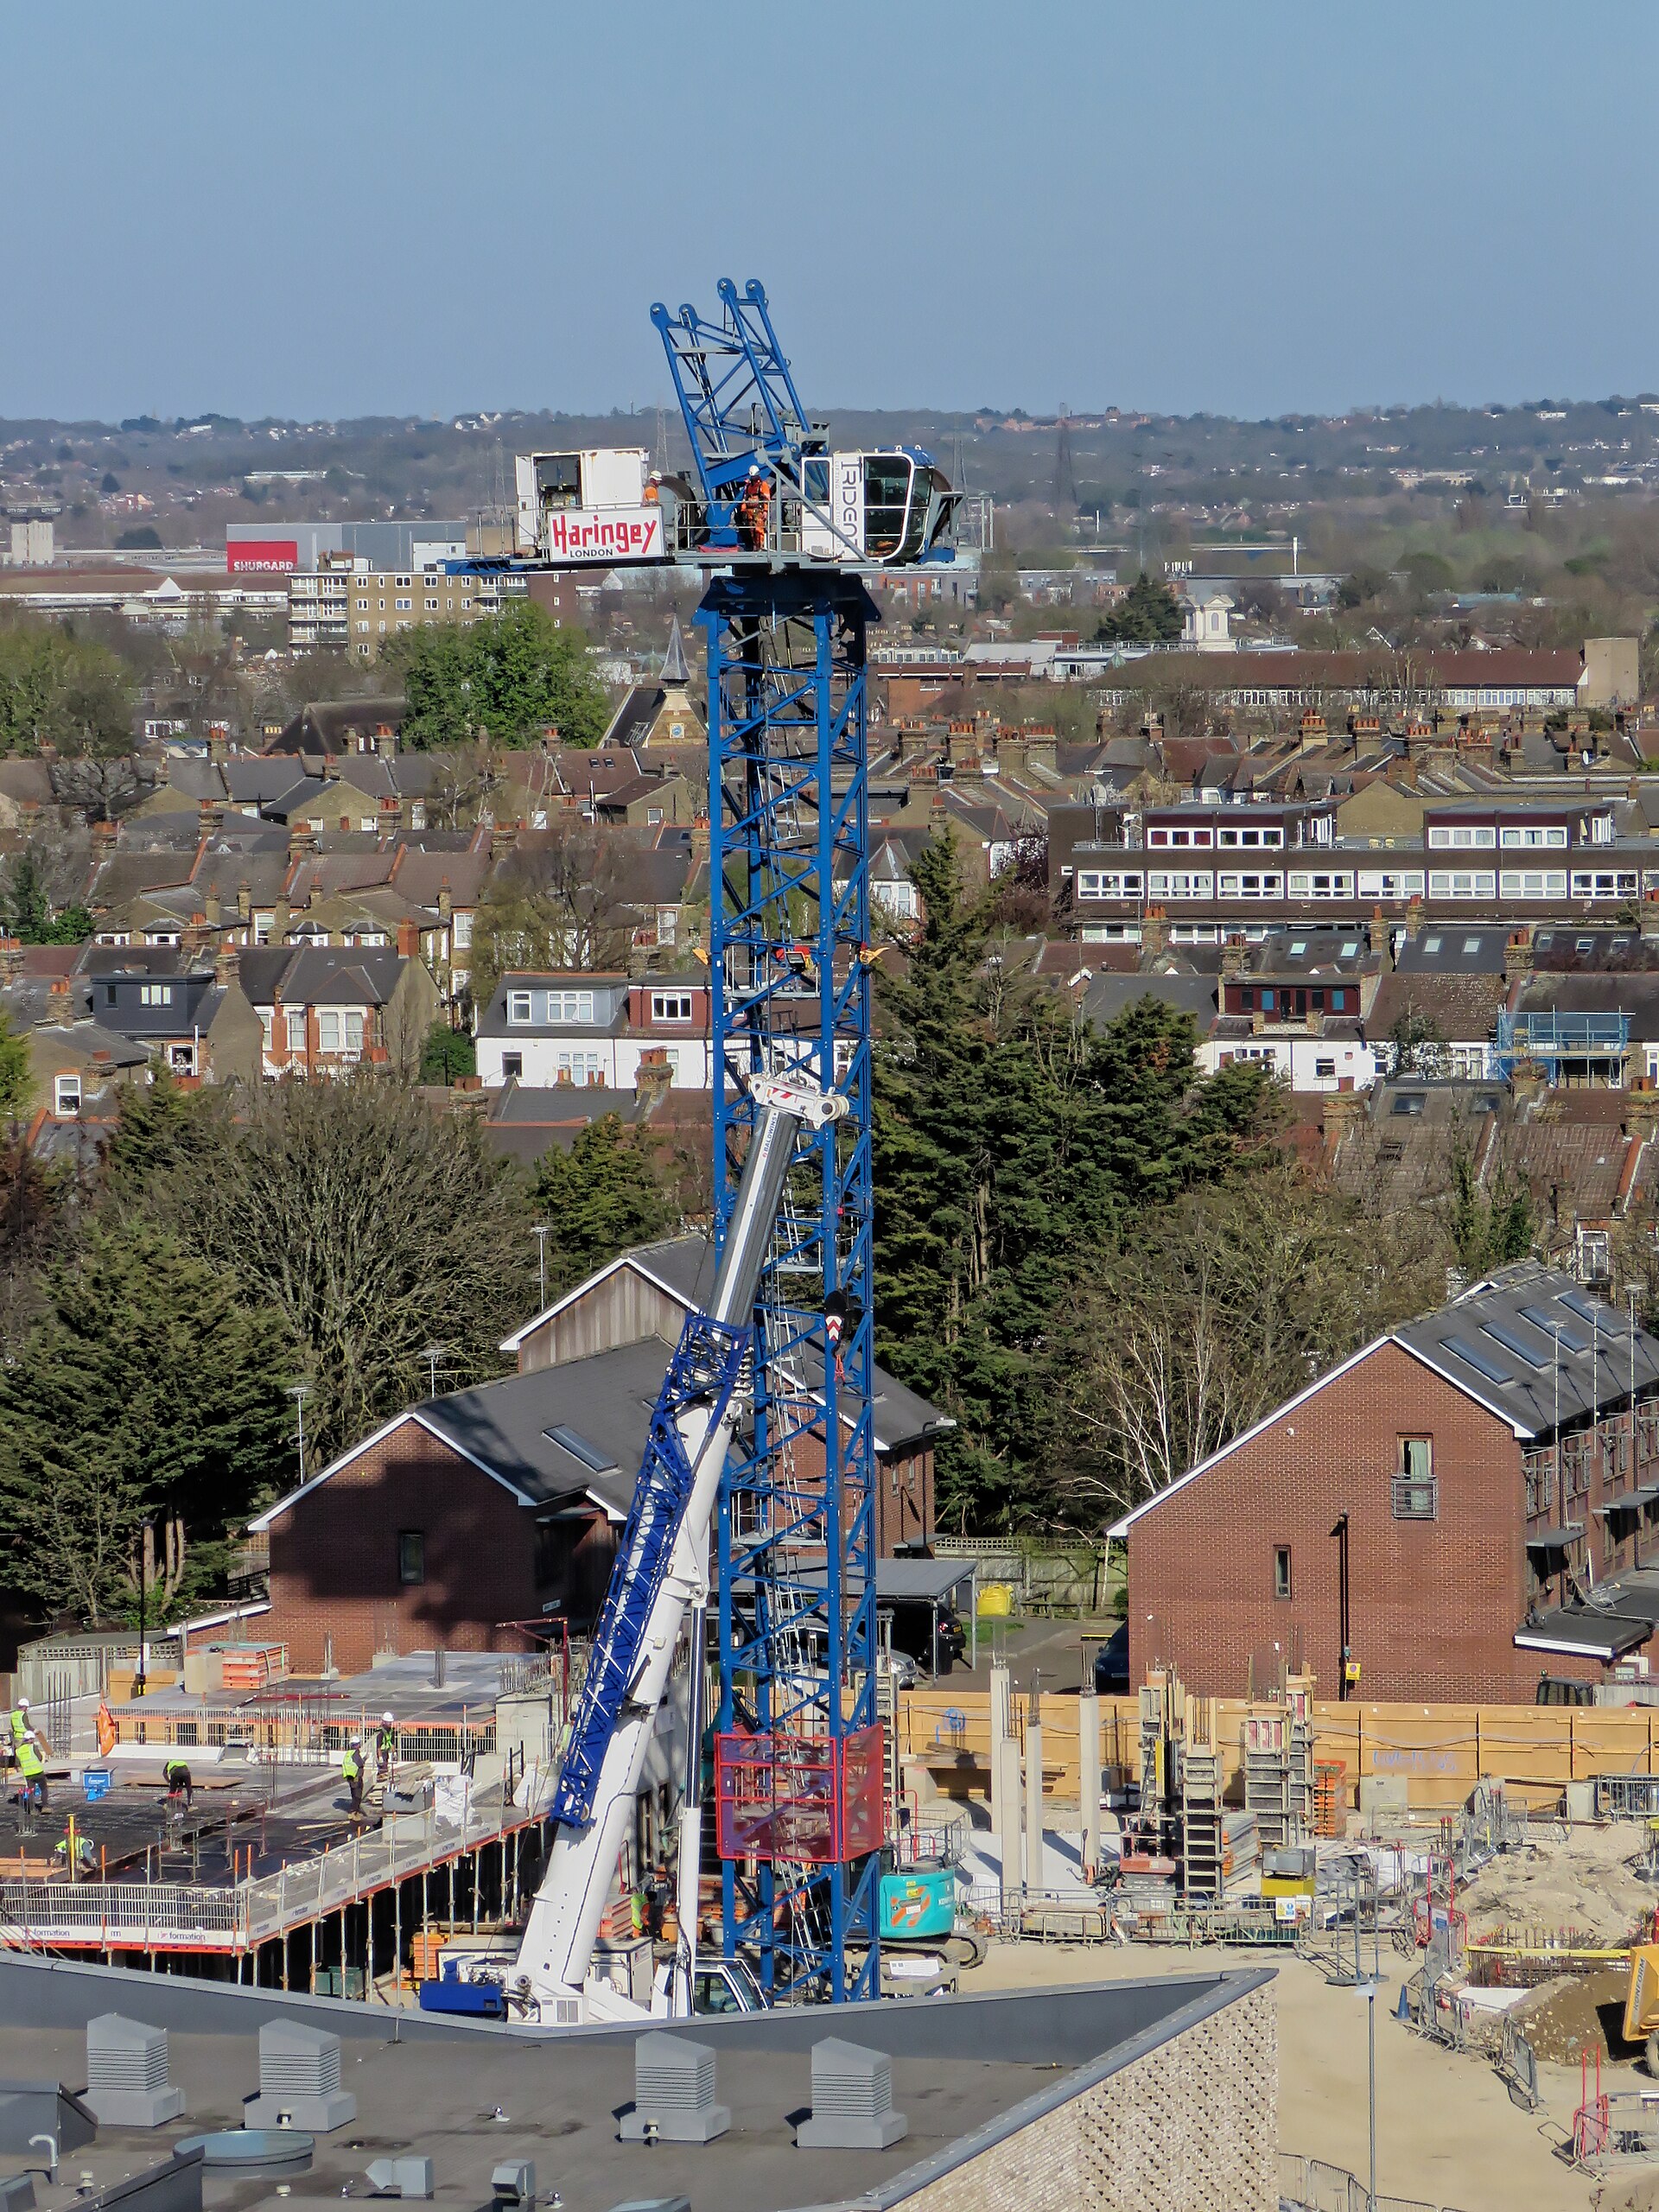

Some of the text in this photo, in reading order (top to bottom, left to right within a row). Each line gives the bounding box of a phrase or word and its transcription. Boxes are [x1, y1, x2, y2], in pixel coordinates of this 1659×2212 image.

[552, 514, 657, 554] Haringey
[570, 549, 613, 558] LONDON
[233, 561, 294, 571] SHURGARD
[763, 1116, 778, 1152] BALDWINS
[34, 1928, 70, 1936] formation
[169, 1930, 206, 1942] formation
[1633, 1957, 1645, 2011] KONFORM
